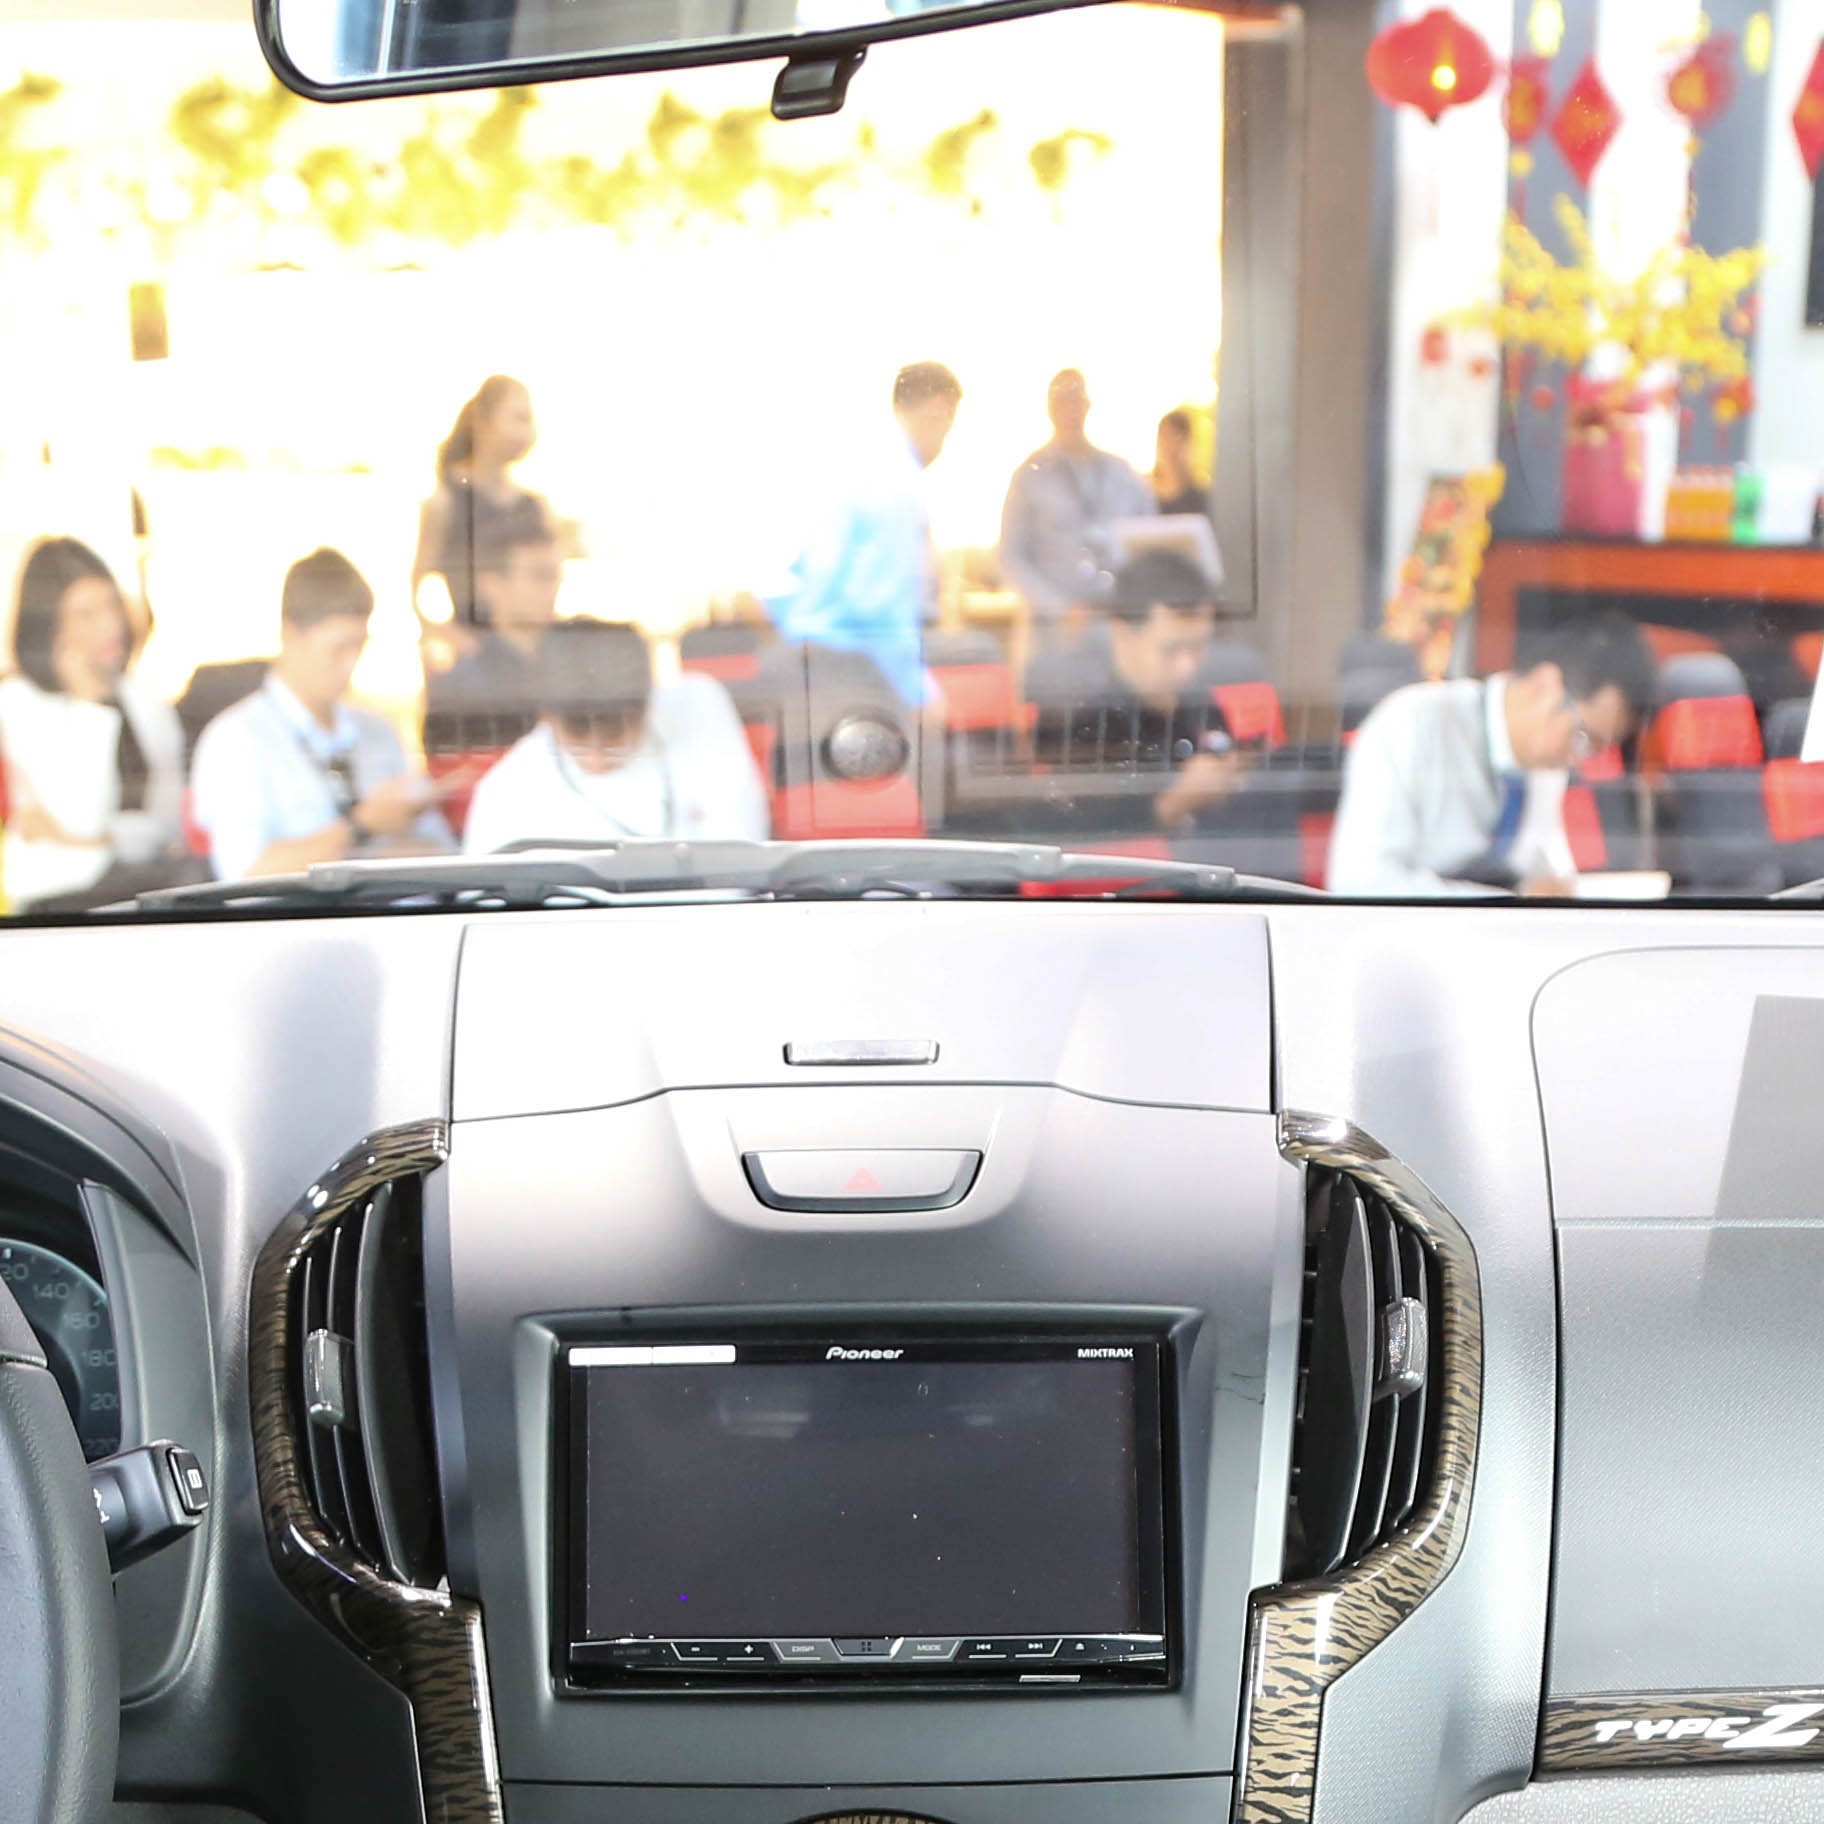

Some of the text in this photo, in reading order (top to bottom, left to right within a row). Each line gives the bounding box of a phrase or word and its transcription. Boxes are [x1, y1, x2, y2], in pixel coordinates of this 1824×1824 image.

[826, 1346, 904, 1361] Pioneer
[1077, 1347, 1134, 1359] MIXTRAX
[1594, 1716, 1752, 1743] TYPE
